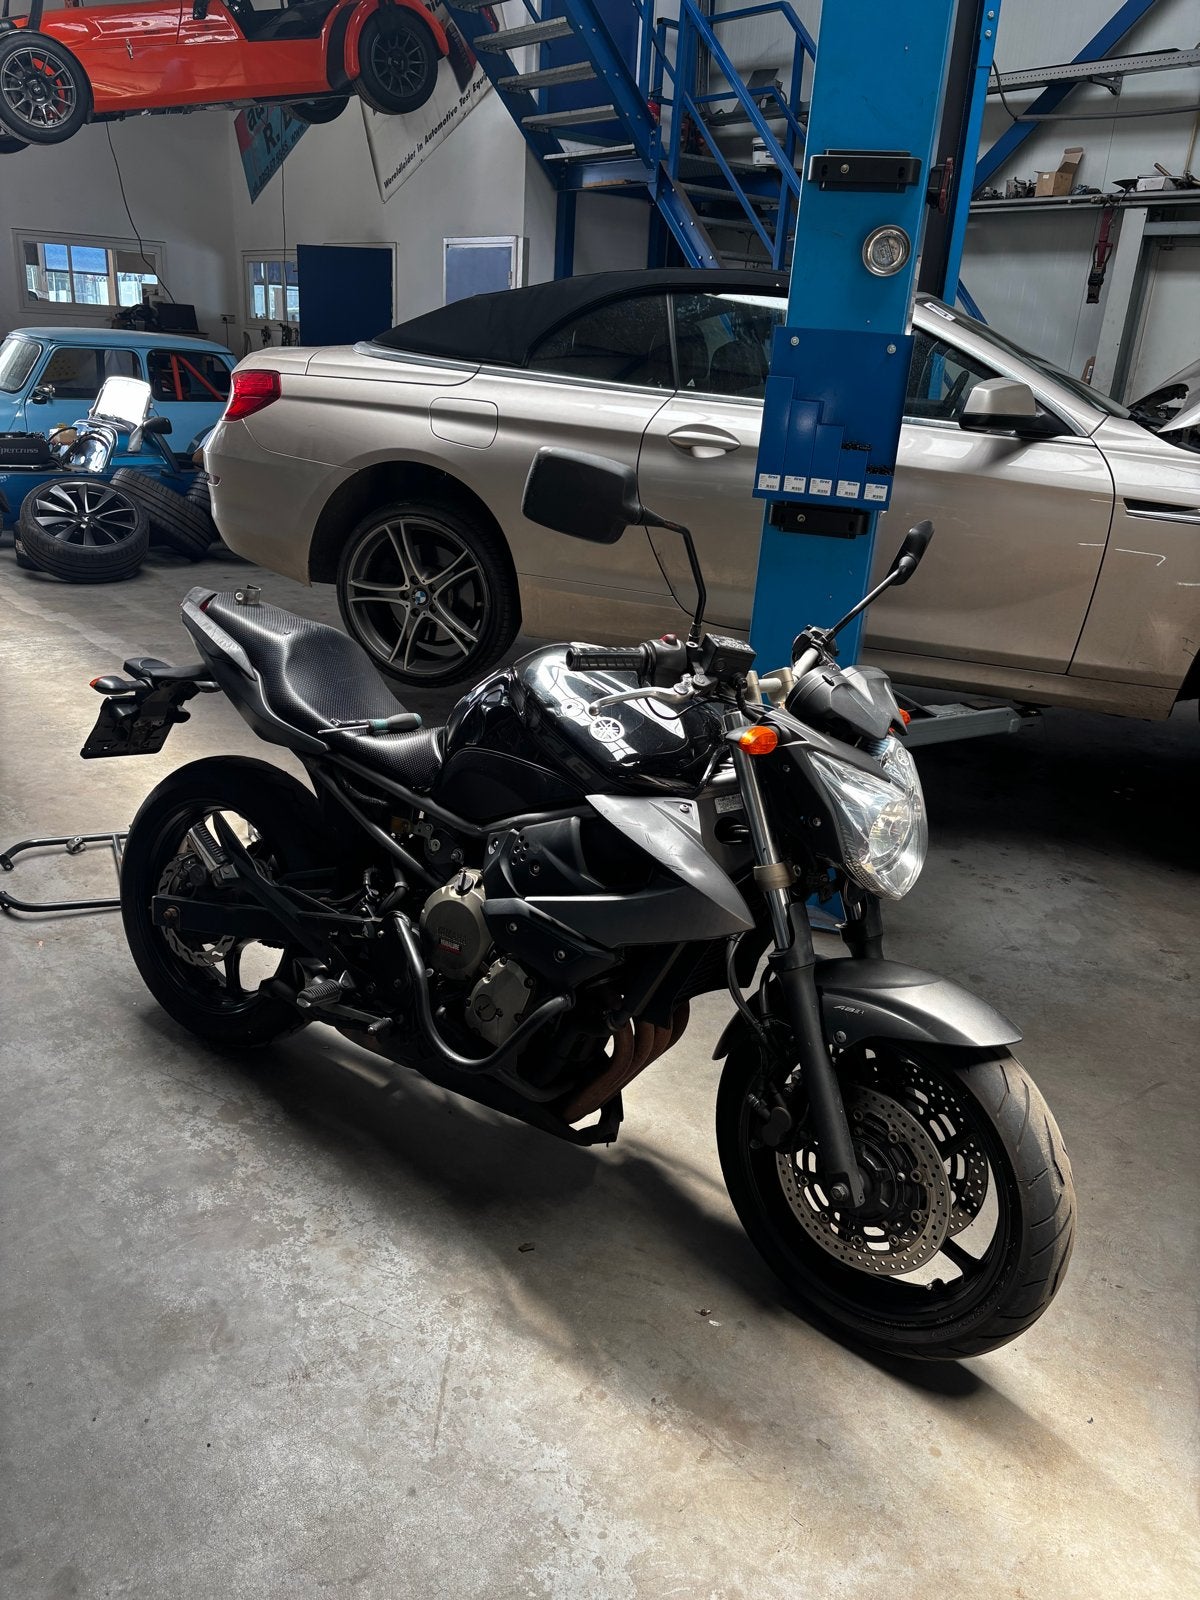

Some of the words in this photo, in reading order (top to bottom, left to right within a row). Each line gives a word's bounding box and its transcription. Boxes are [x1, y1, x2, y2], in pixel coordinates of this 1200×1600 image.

[383, 151, 416, 189] Wereldleider
[416, 142, 424, 153] in
[424, 105, 458, 145] Automotive
[459, 89, 471, 107] Test
